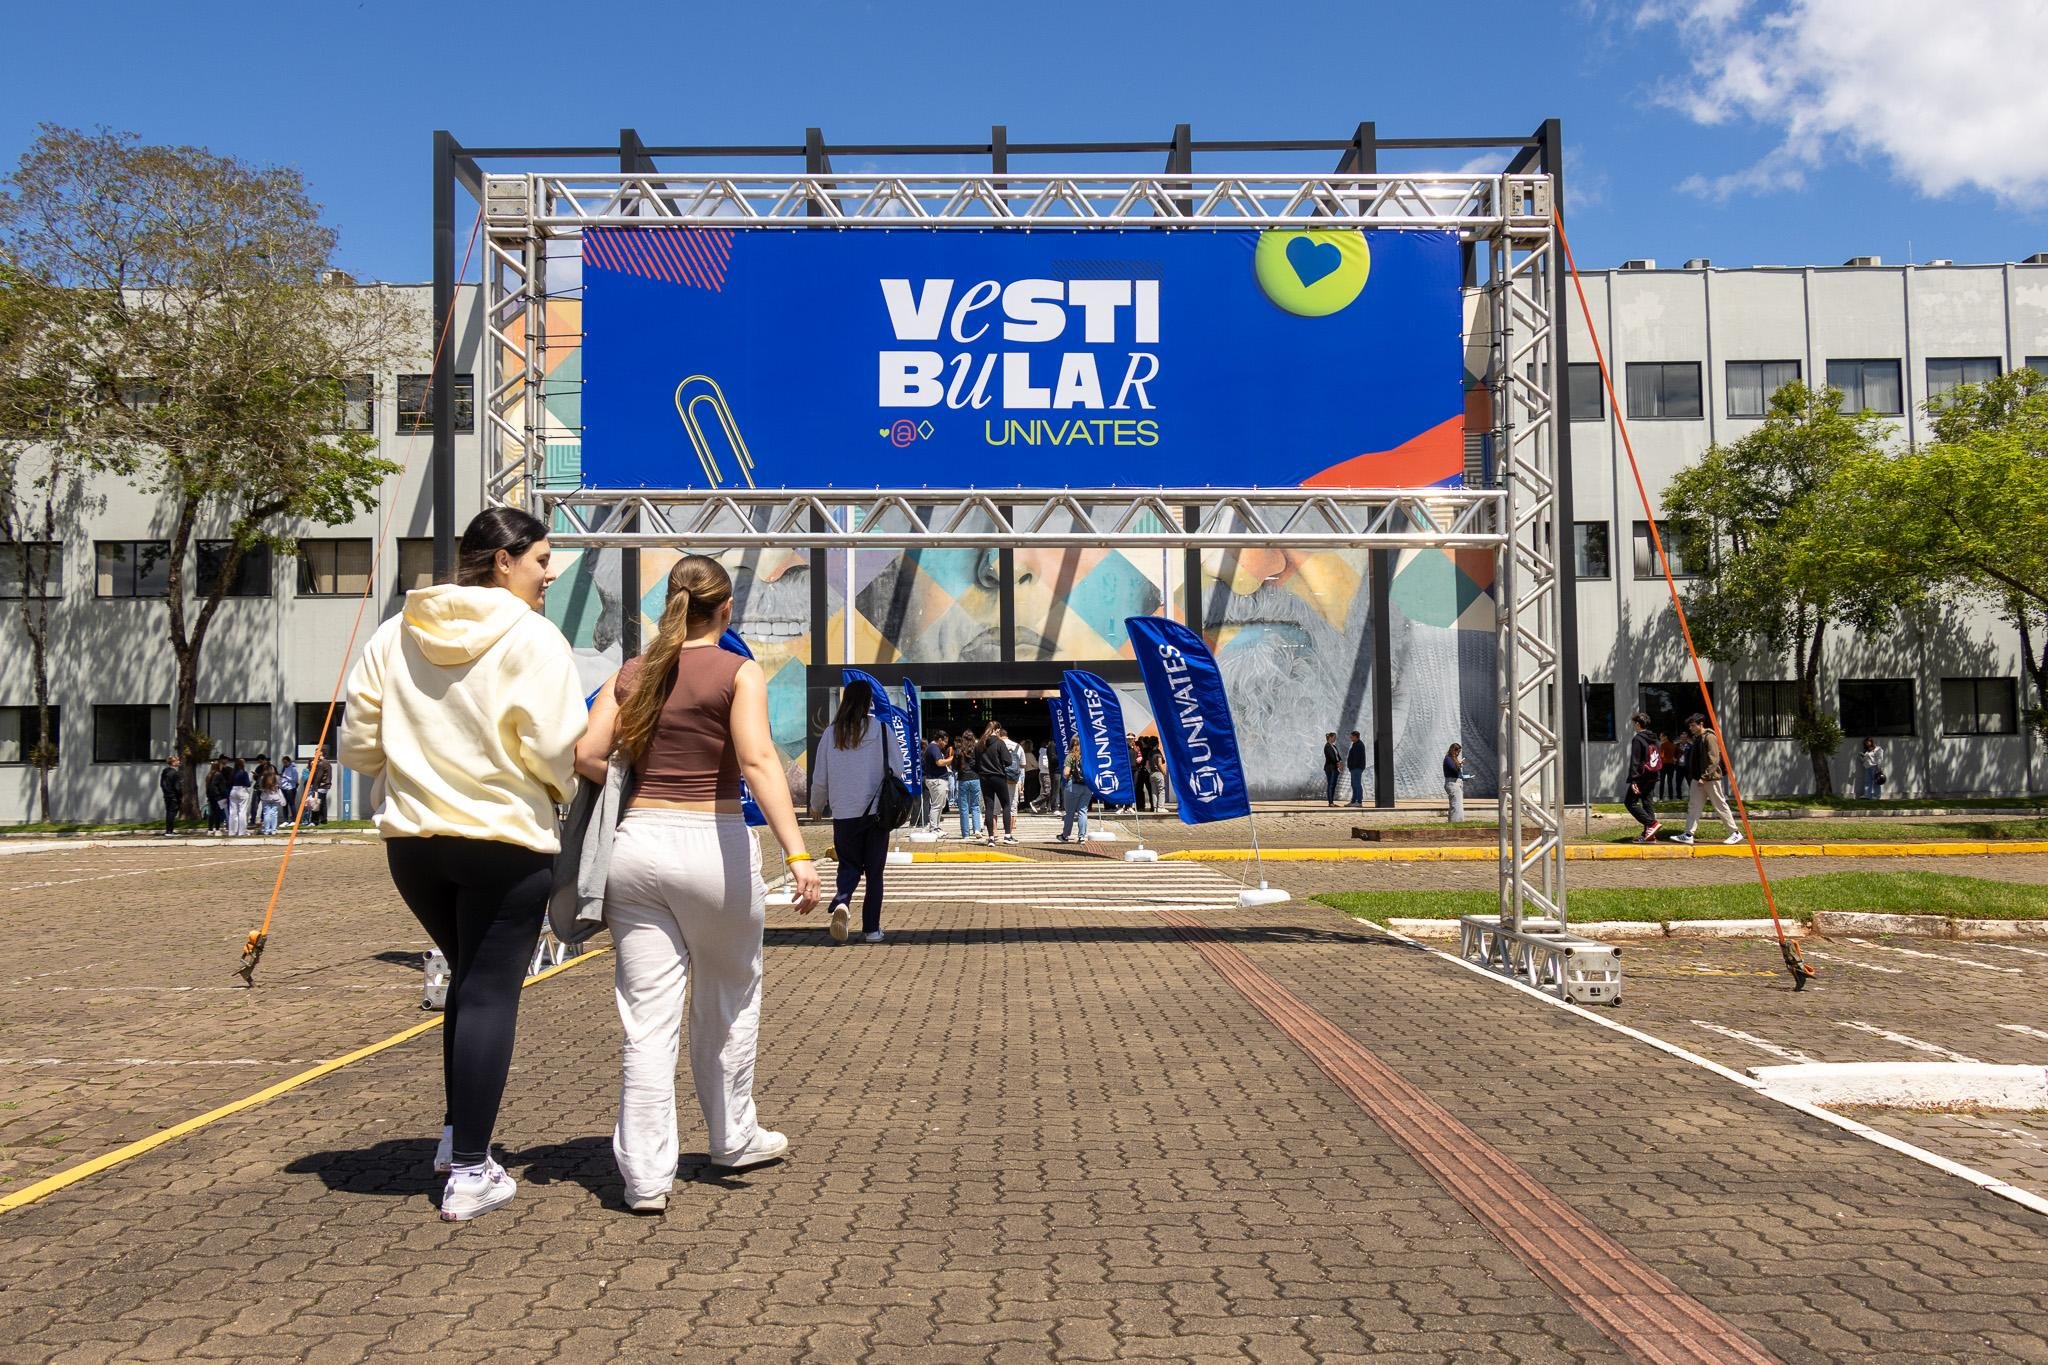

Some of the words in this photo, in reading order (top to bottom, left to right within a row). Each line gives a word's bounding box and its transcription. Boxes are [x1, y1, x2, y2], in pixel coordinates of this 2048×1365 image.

[985, 420, 1159, 446] UNIVATES
[1084, 688, 1112, 769] UNIVATES
[1158, 643, 1212, 763] UNIVATES
